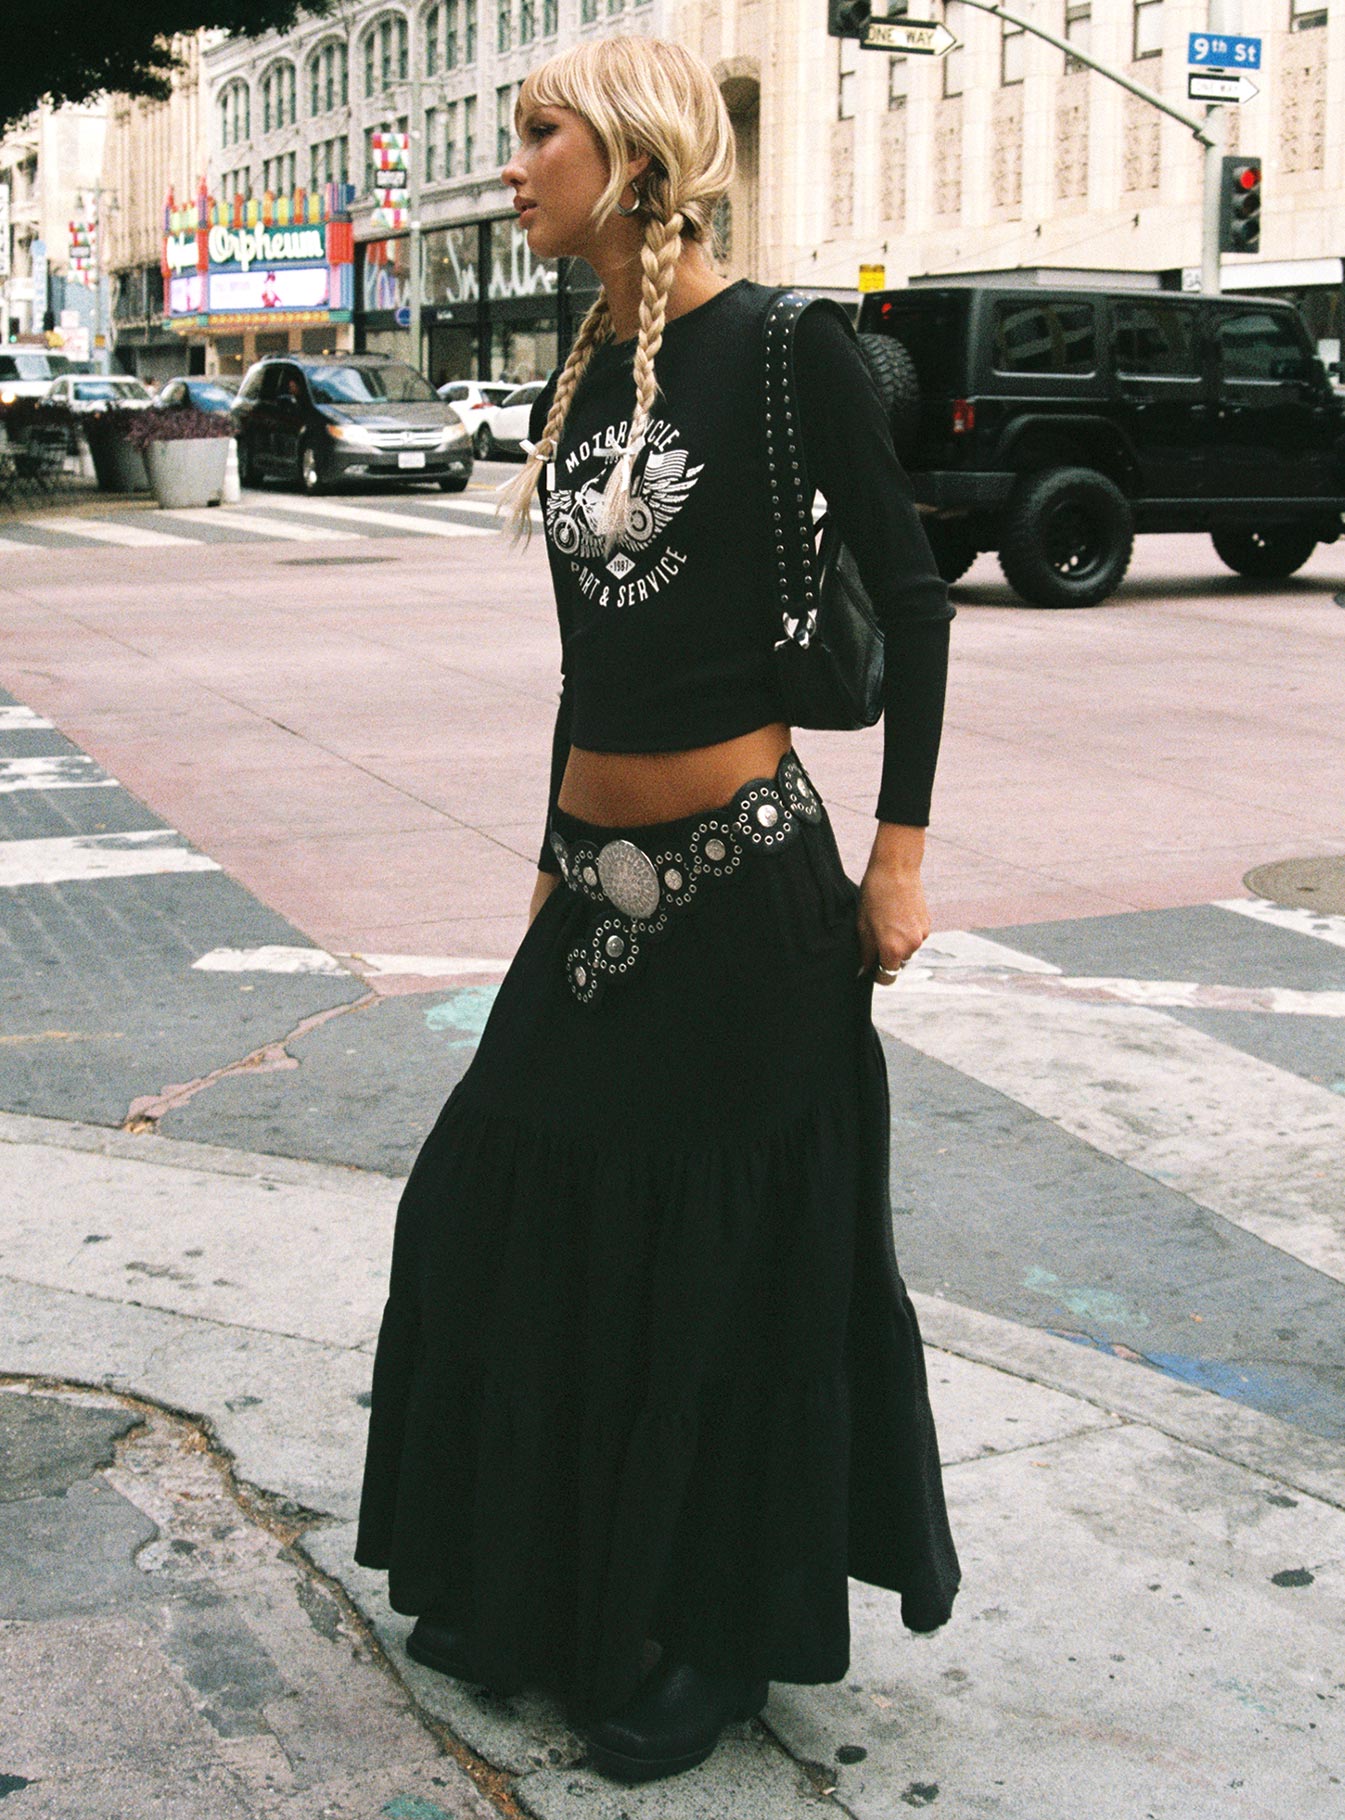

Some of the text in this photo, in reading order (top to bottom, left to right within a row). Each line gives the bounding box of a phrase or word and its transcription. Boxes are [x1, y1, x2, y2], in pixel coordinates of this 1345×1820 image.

[869, 25, 934, 45] ONE WAY
[1194, 38, 1257, 62] 9th St
[208, 221, 324, 272] Orpheum
[565, 419, 680, 474] MOTORYCLE
[599, 586, 610, 607] &
[617, 546, 688, 608] SERVICE
[613, 559, 629, 571] 1987
